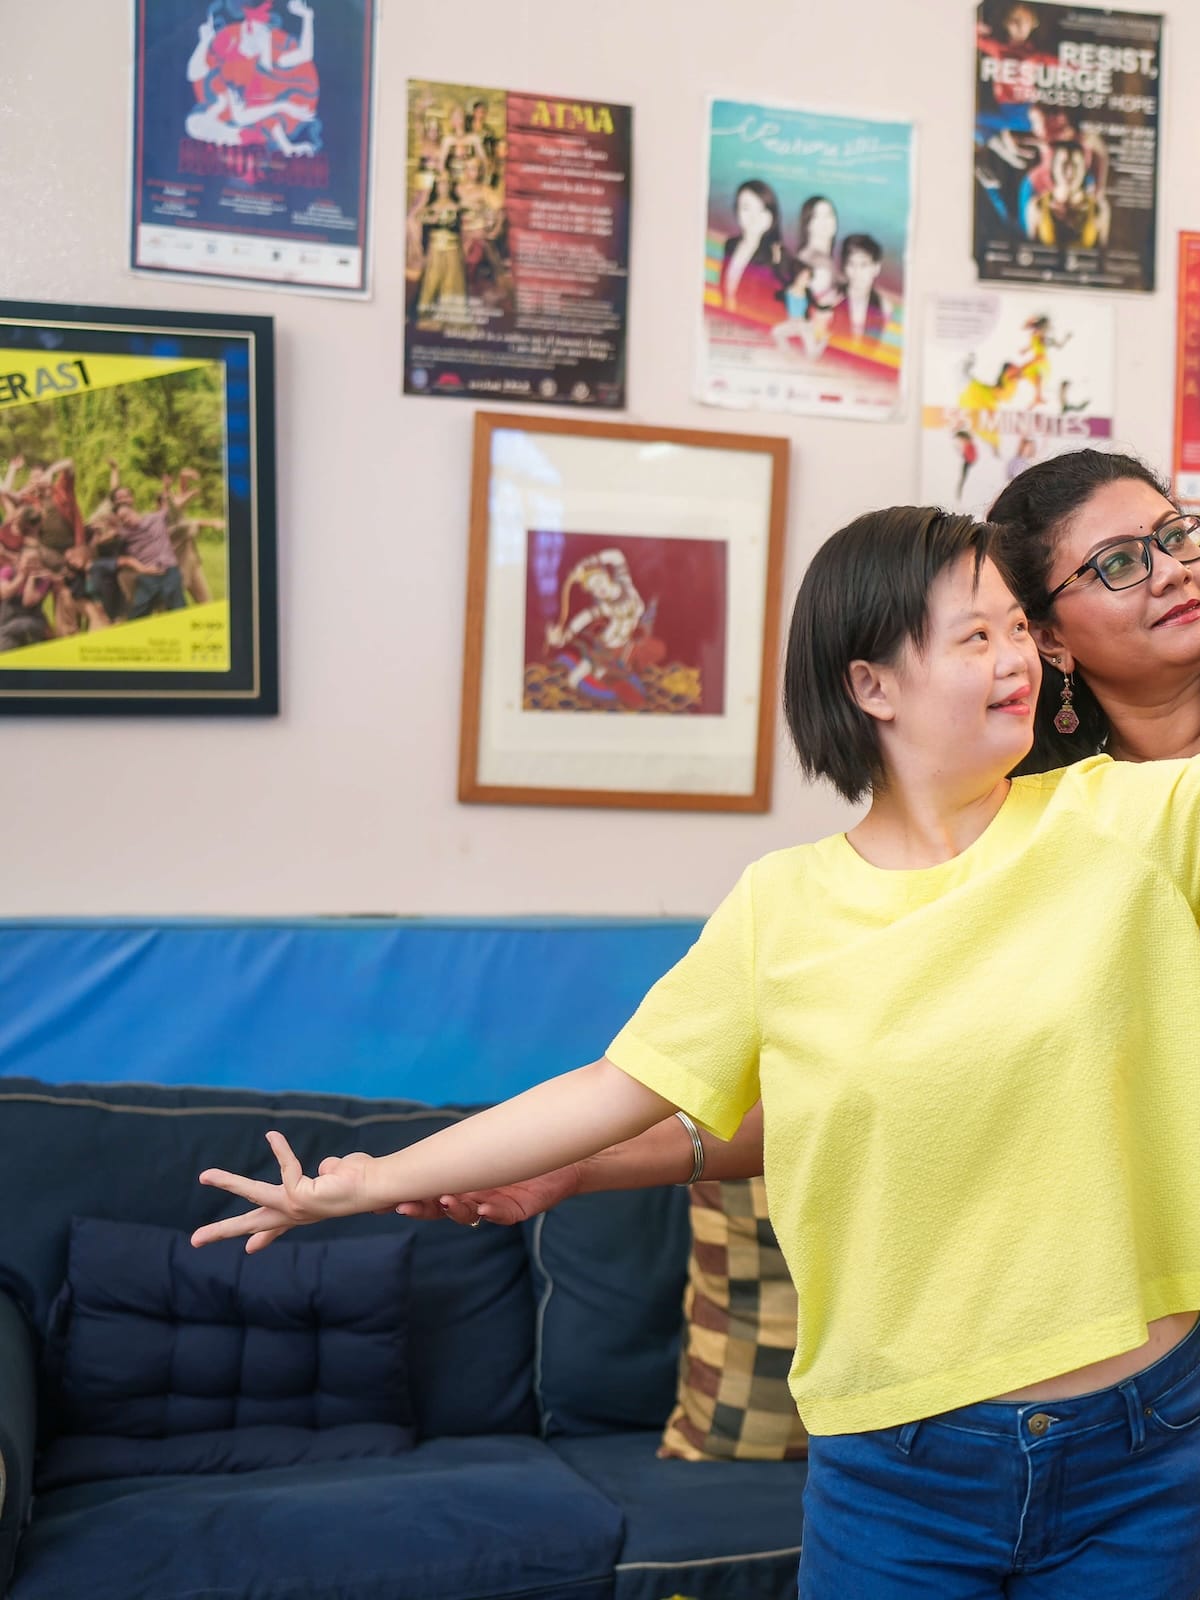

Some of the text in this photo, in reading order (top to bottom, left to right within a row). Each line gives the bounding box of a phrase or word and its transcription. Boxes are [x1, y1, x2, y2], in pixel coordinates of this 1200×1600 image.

[981, 57, 1113, 94] RESURGE
[1058, 41, 1158, 80] RESIST,
[530, 100, 615, 135] ATMA
[1013, 86, 1156, 115] TRACES OF HOPE
[979, 409, 1091, 437] MINUTES
